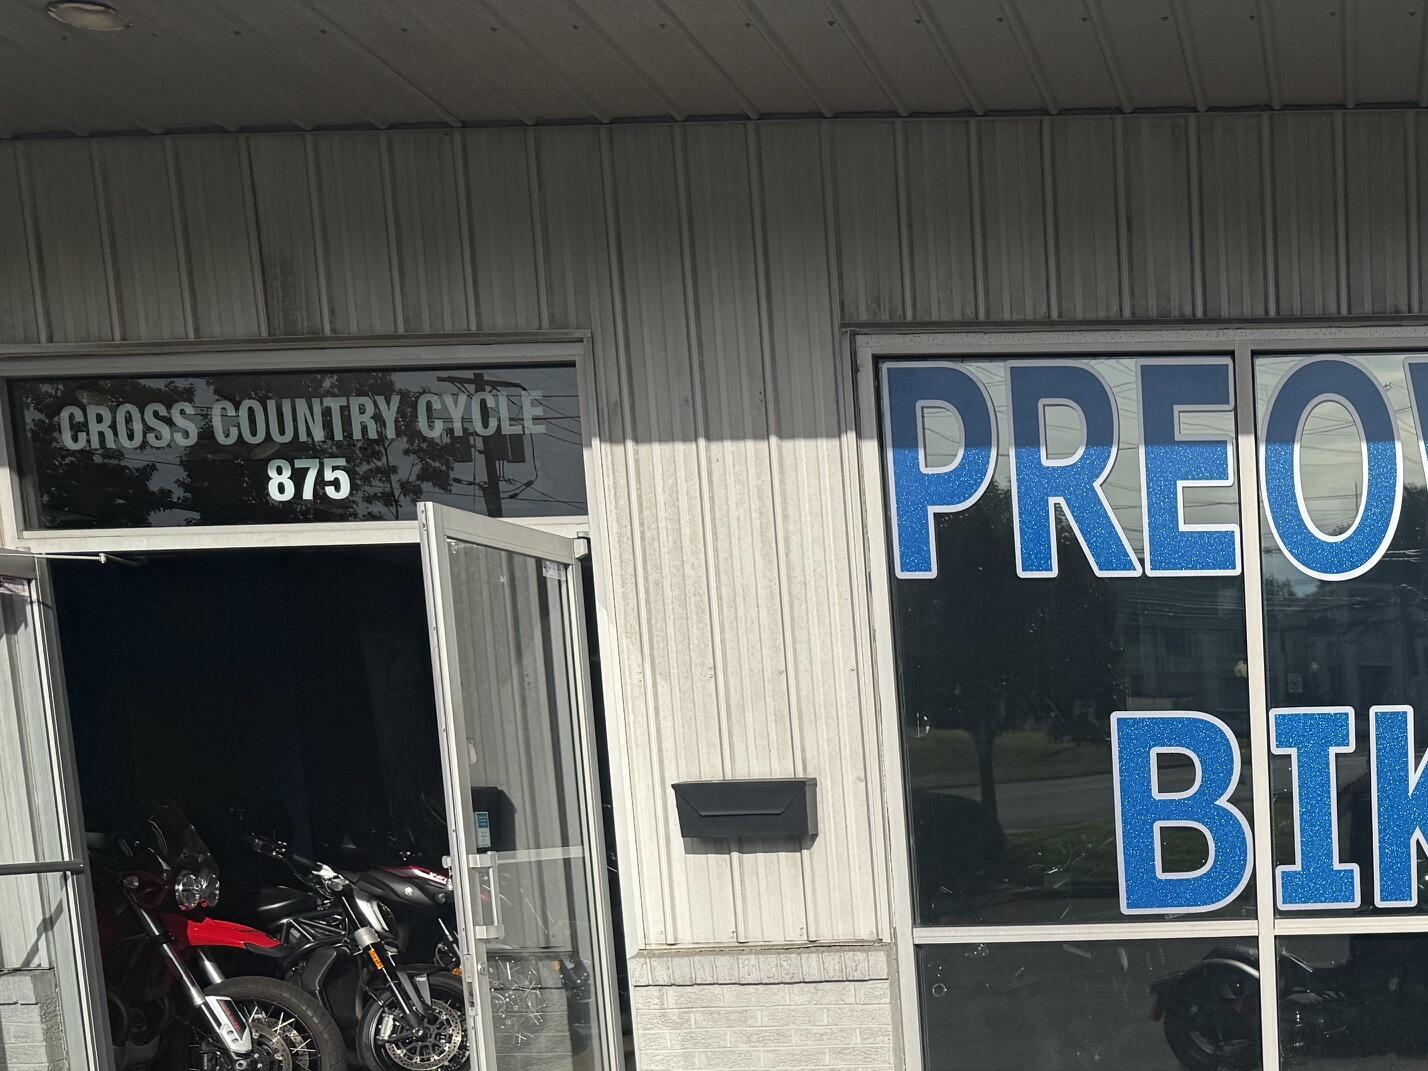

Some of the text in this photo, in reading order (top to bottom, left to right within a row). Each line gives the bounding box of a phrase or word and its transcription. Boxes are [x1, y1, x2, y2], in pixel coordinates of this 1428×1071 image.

[61, 390, 546, 450] CROSS COUNTRY CYCLE
[267, 458, 350, 501] 875
